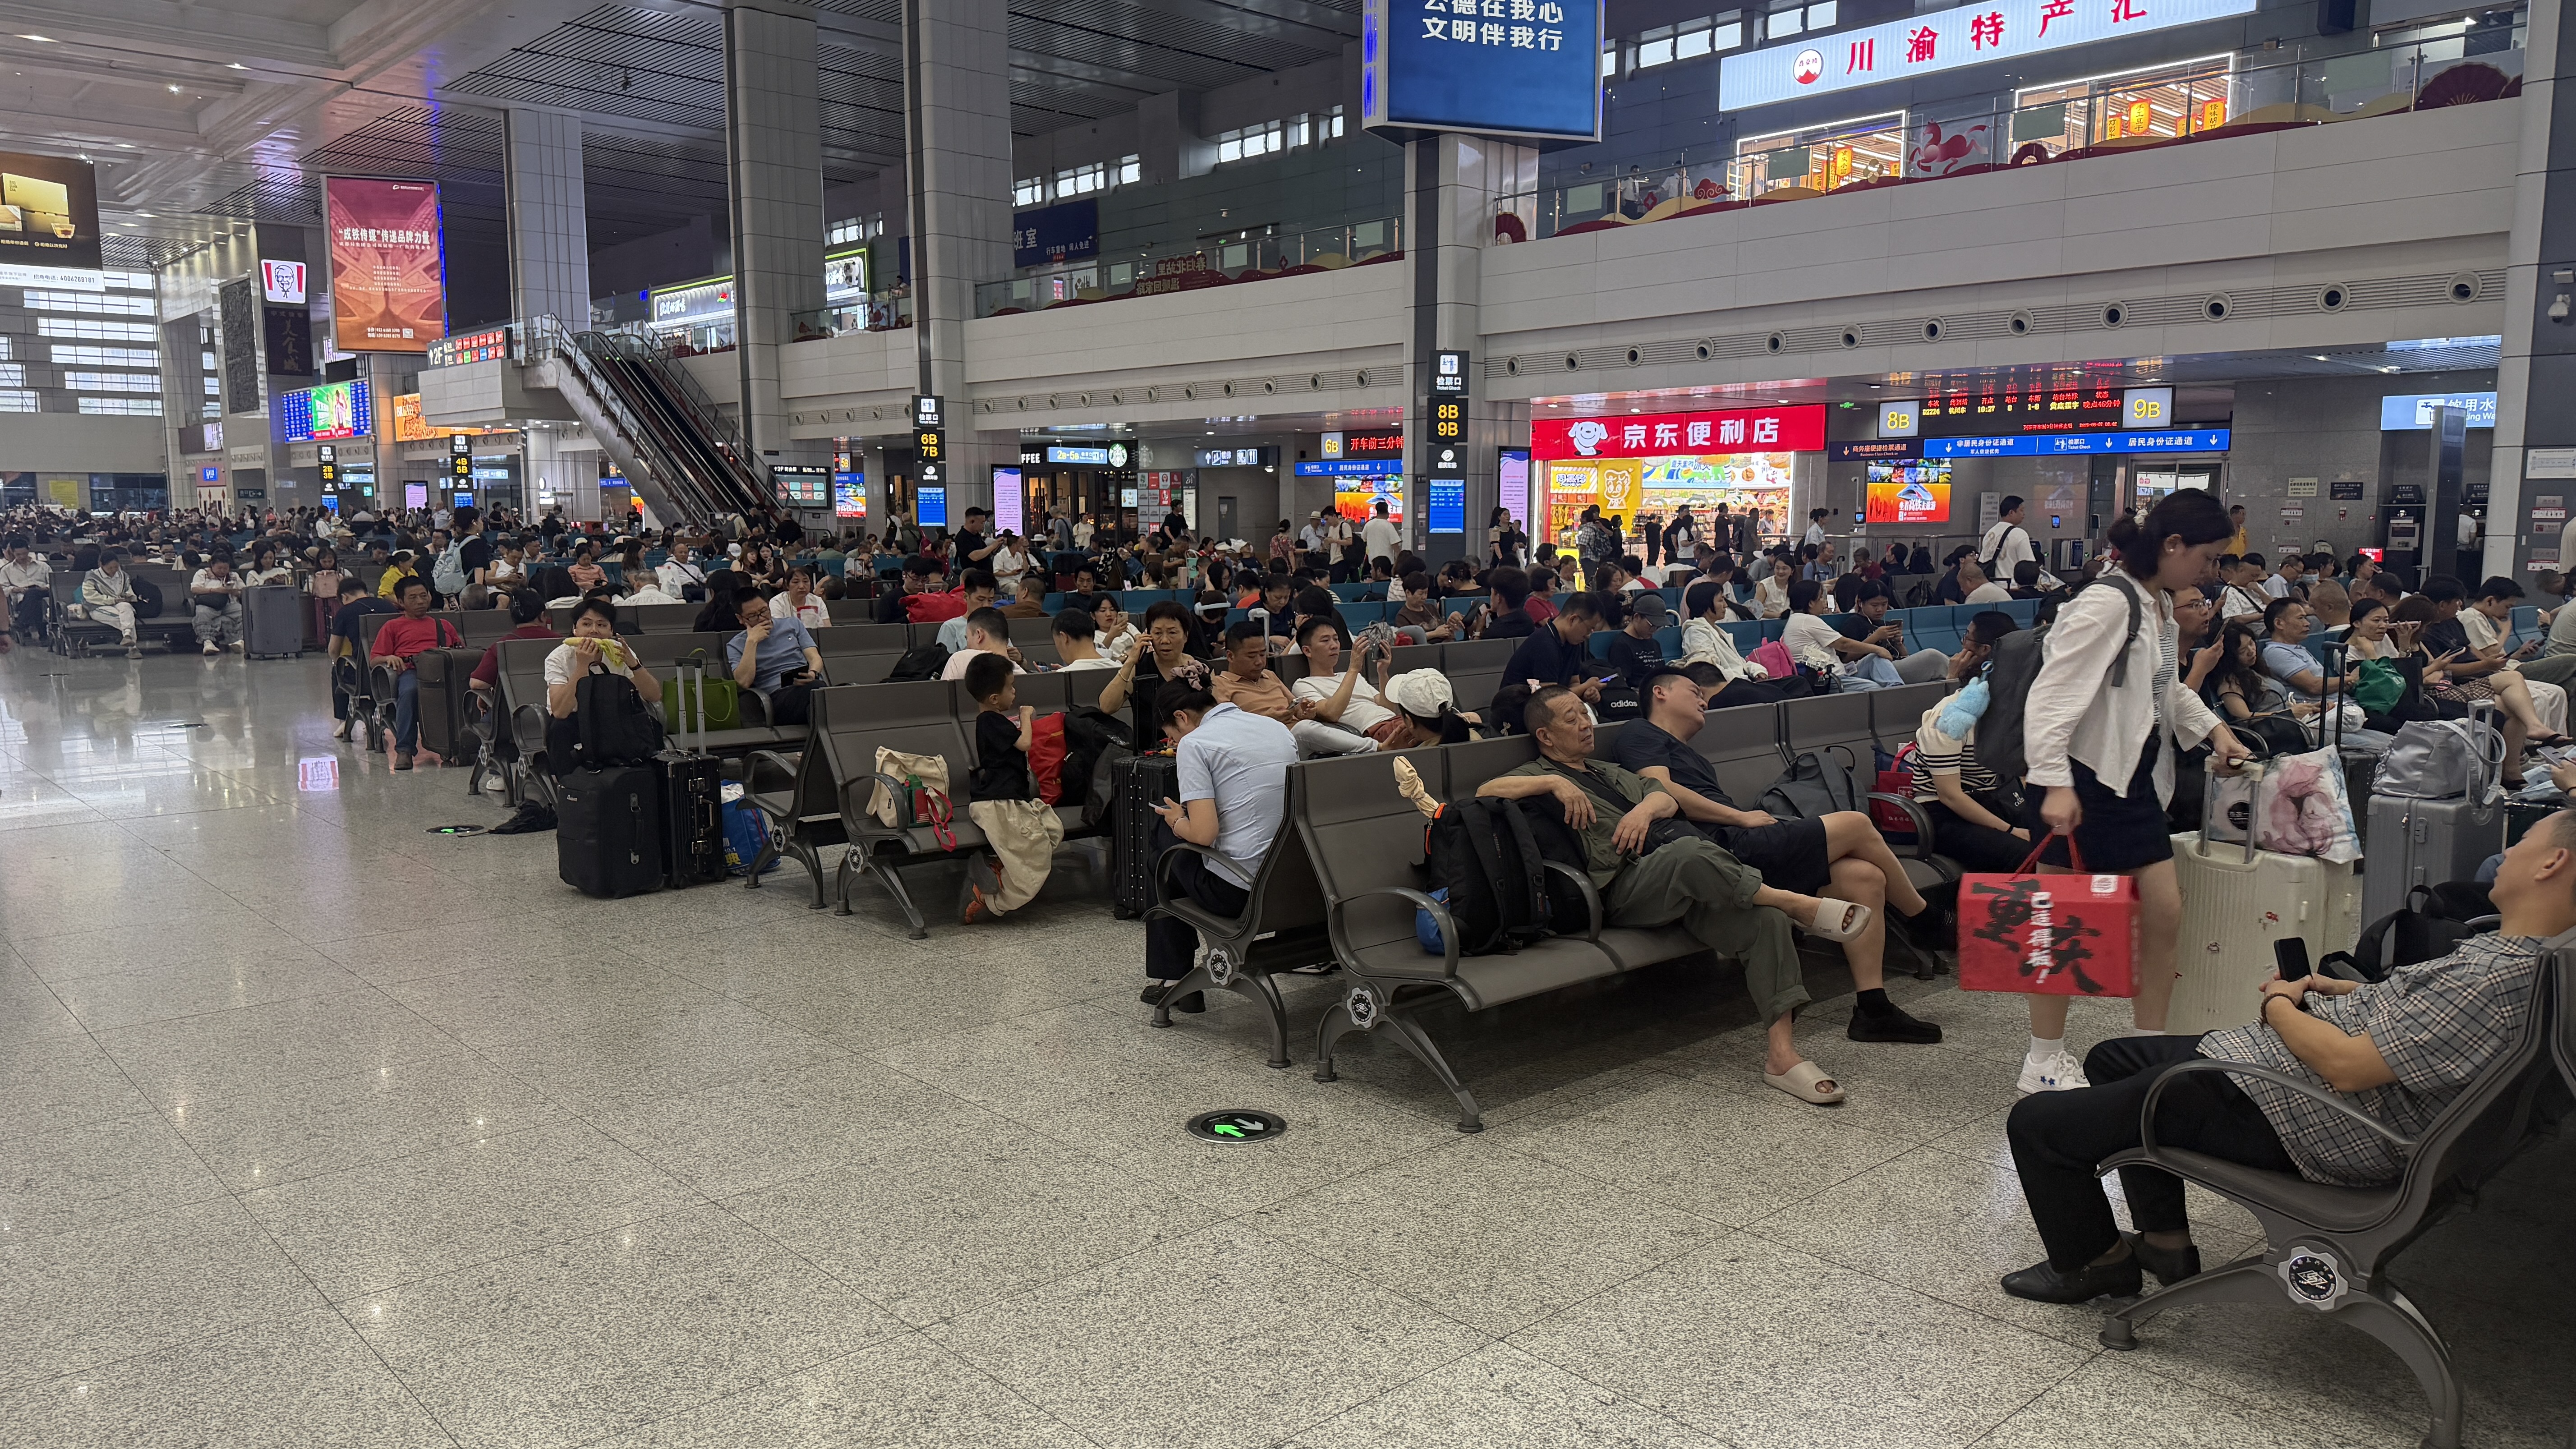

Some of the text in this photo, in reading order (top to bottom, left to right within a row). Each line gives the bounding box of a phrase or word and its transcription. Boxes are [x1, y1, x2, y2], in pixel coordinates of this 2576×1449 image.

[1421, 17, 1563, 51] 文明伴我行
[1847, 0, 2148, 74] 川渝特产汇
[2134, 104, 2144, 131] 手工豆干
[1436, 376, 1462, 386] 检票口
[1438, 404, 1458, 419] 8B
[2134, 399, 2161, 419] 9B
[1887, 411, 1910, 429] 8B
[1438, 422, 1458, 436] 9B
[1624, 417, 1780, 449] 京东便利店
[921, 433, 938, 445] 6B
[1325, 439, 1339, 453] 6B
[1350, 436, 1404, 451] 开车前三分钟
[1957, 438, 2014, 447] 非居民身份证通道
[2128, 436, 2193, 446] 居民身份证通道
[922, 446, 938, 457] 7B
[1610, 699, 1638, 708] adidas
